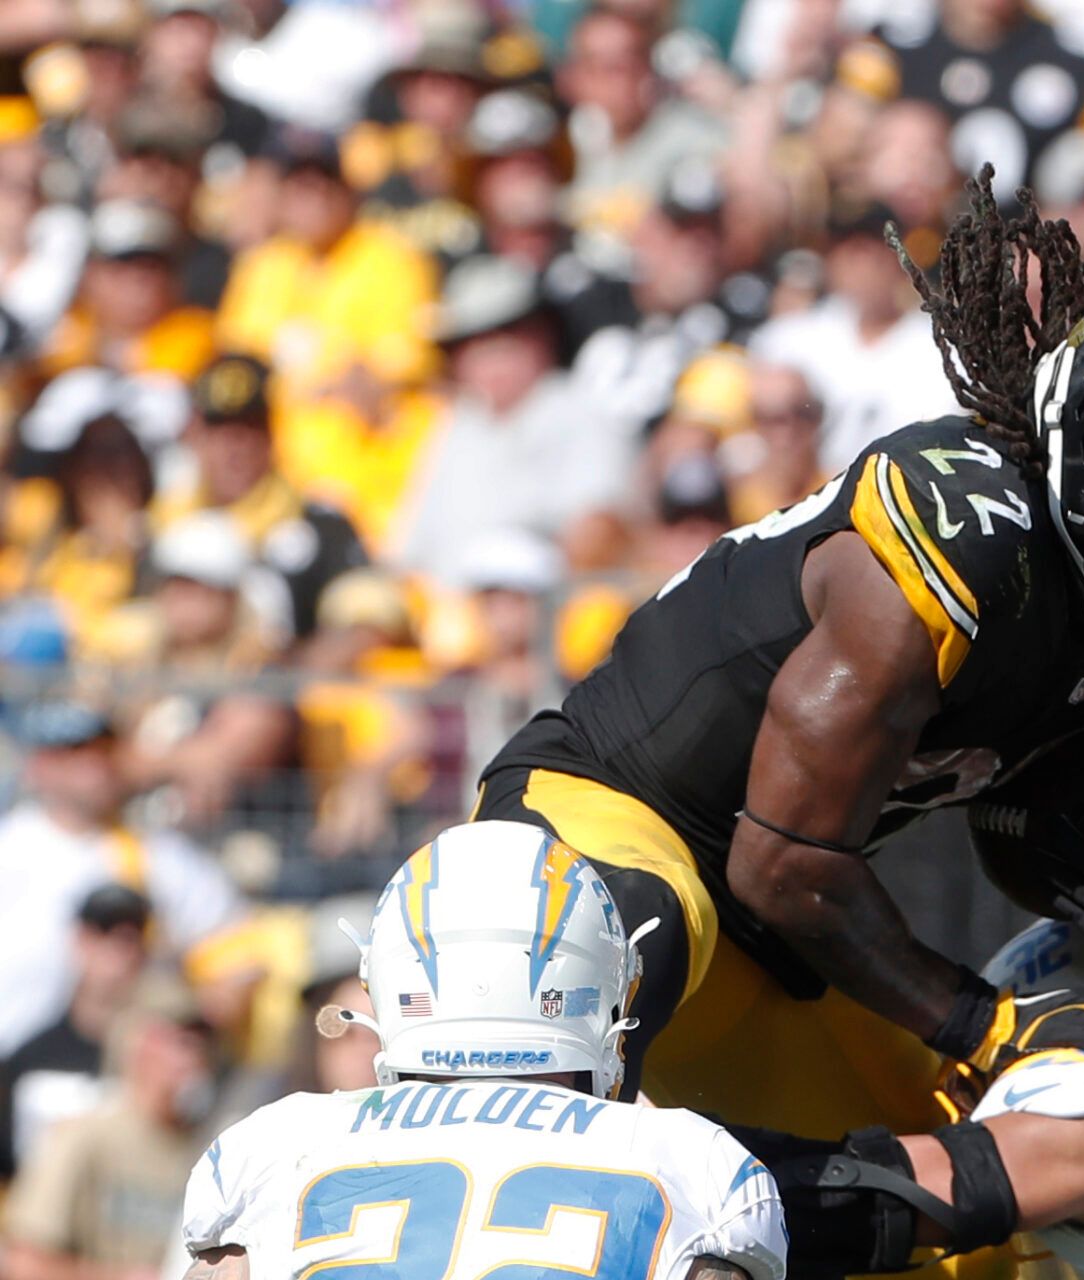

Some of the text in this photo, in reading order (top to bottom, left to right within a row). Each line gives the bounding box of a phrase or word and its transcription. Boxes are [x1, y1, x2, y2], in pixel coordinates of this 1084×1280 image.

[918, 436, 1032, 536] 22
[421, 1050, 552, 1072] CHARGERS
[349, 1083, 609, 1135] MOLDEN
